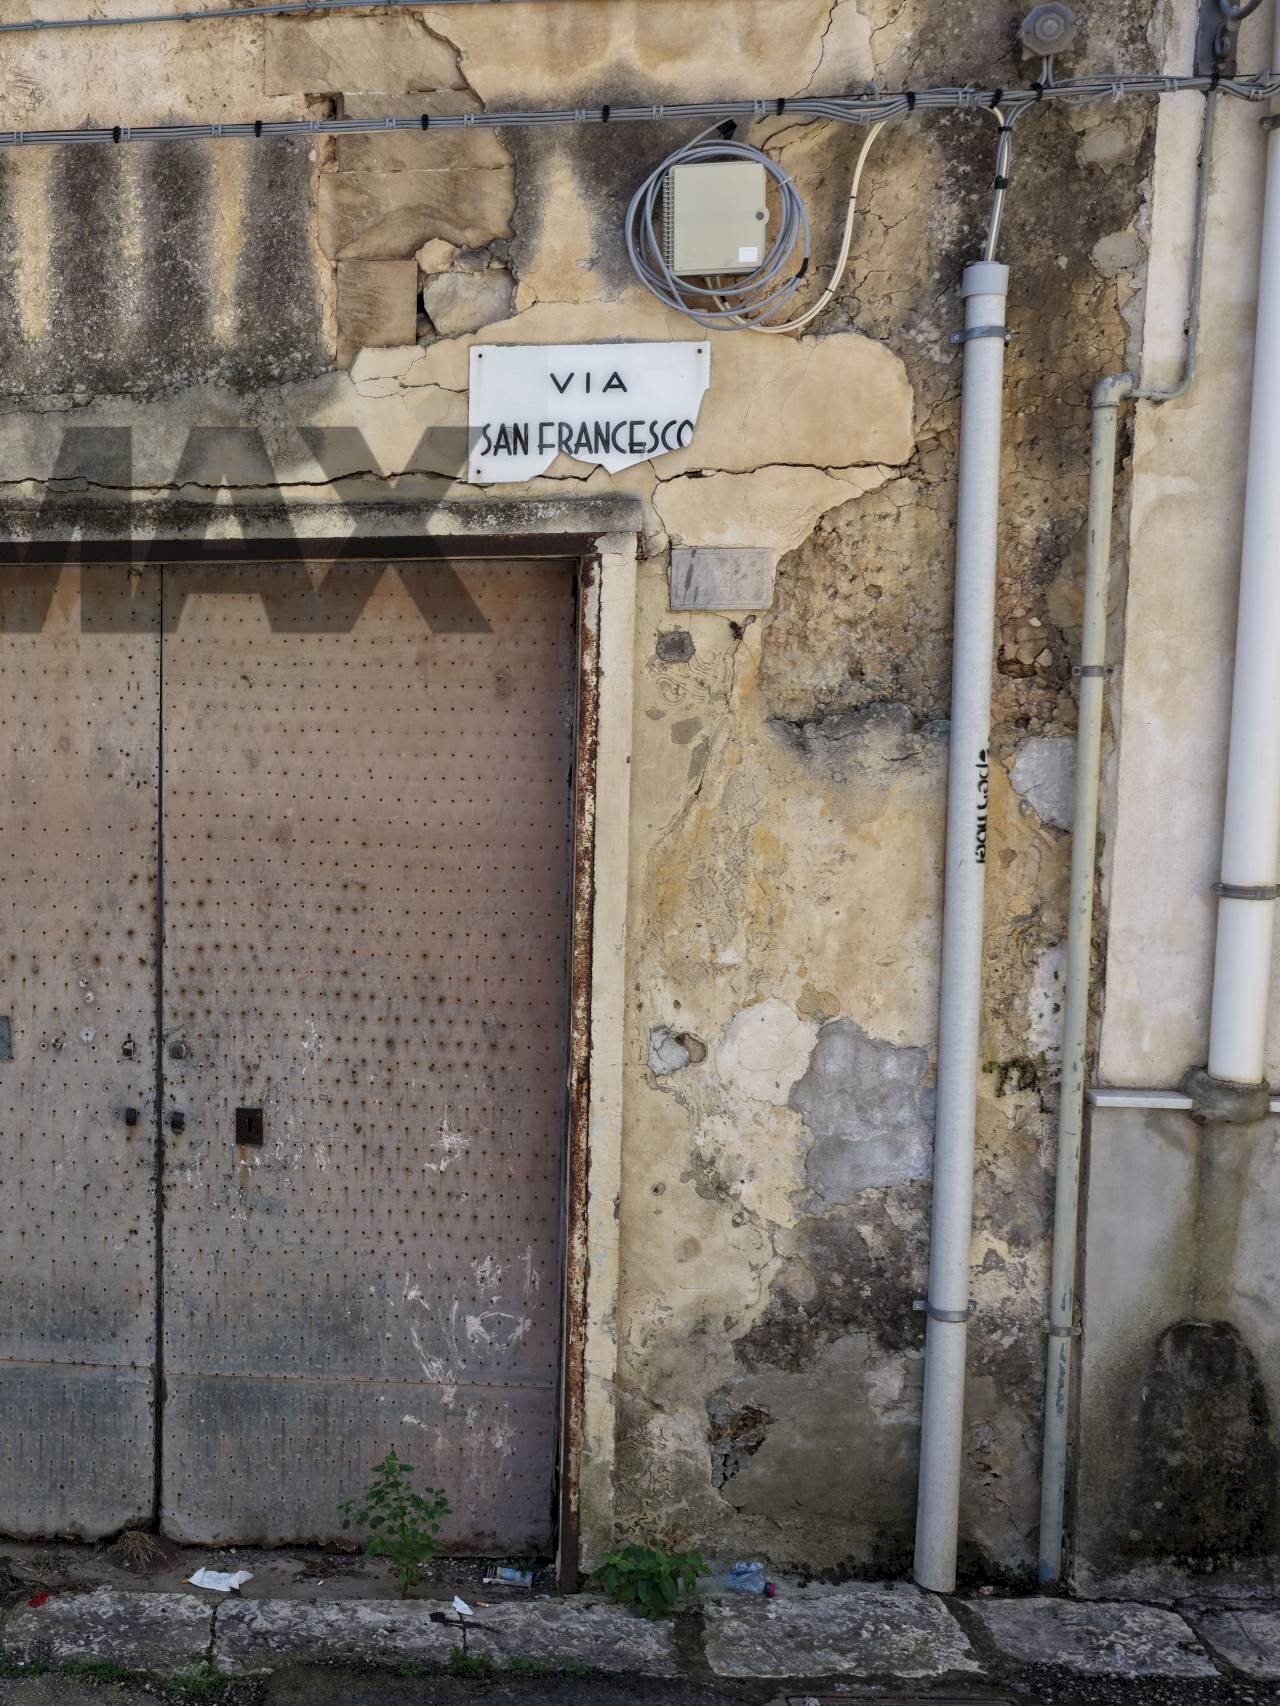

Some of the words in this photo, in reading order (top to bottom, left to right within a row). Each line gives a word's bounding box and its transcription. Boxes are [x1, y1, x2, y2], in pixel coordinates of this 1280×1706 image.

[549, 371, 628, 394] VIA
[480, 422, 529, 456] SAN
[537, 419, 695, 456] FRANCESCO
